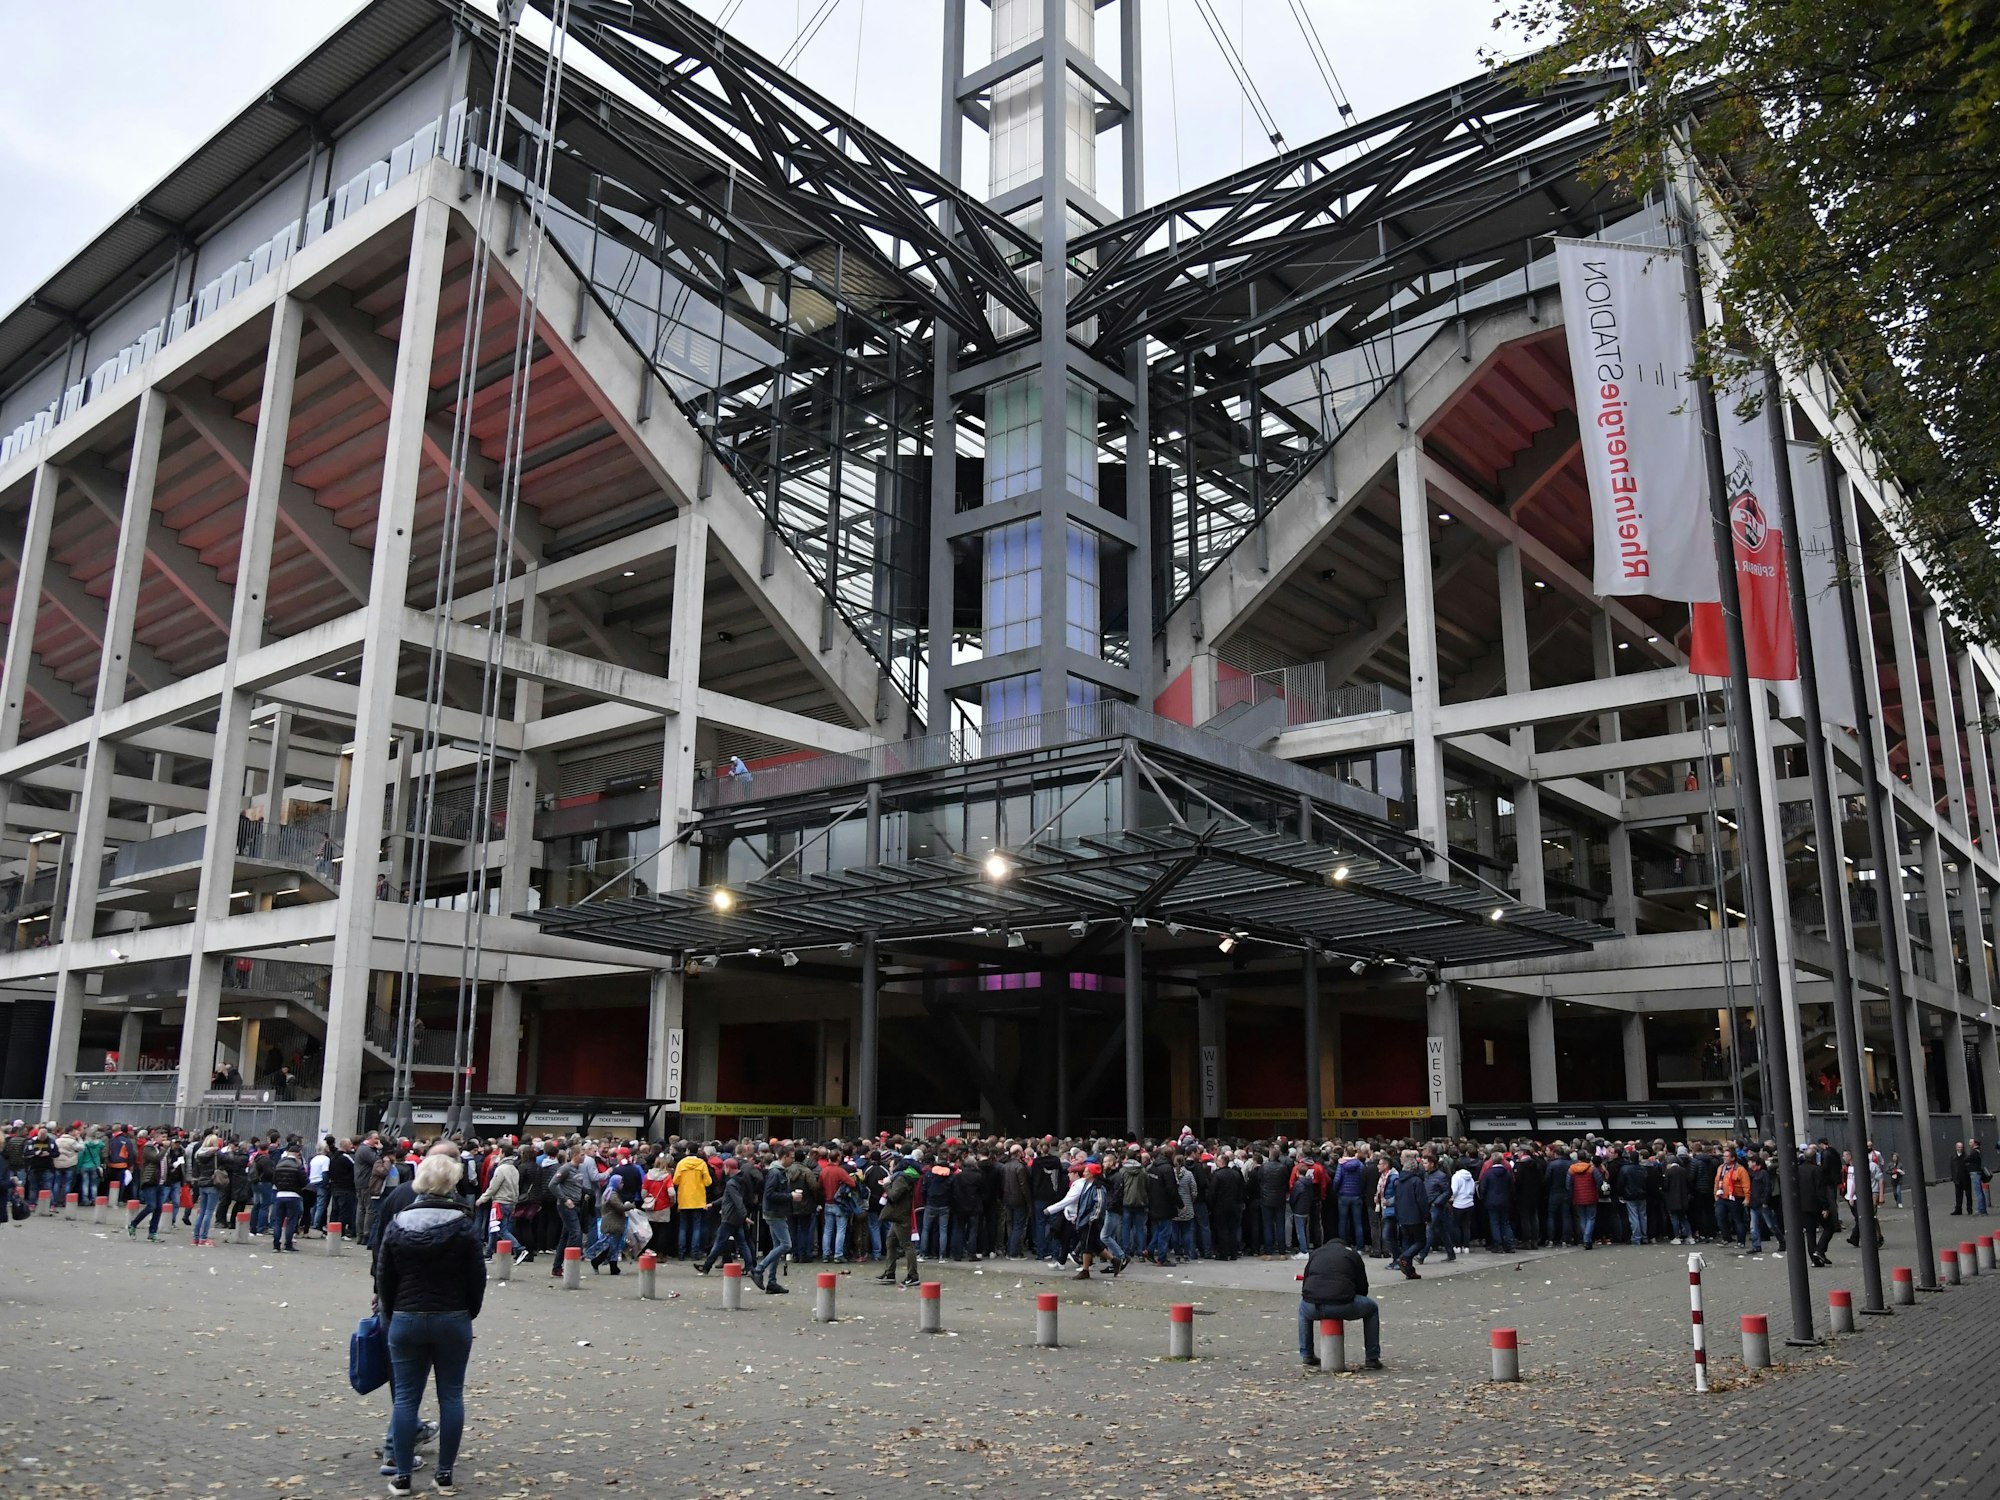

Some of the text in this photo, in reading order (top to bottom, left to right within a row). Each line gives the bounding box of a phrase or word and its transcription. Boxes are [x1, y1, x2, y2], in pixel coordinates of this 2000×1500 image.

[669, 1033, 680, 1099] NORD
[1203, 1049, 1215, 1107] WEST
[1428, 1041, 1442, 1103] WEST
[1391, 1109, 1414, 1117] Airport
